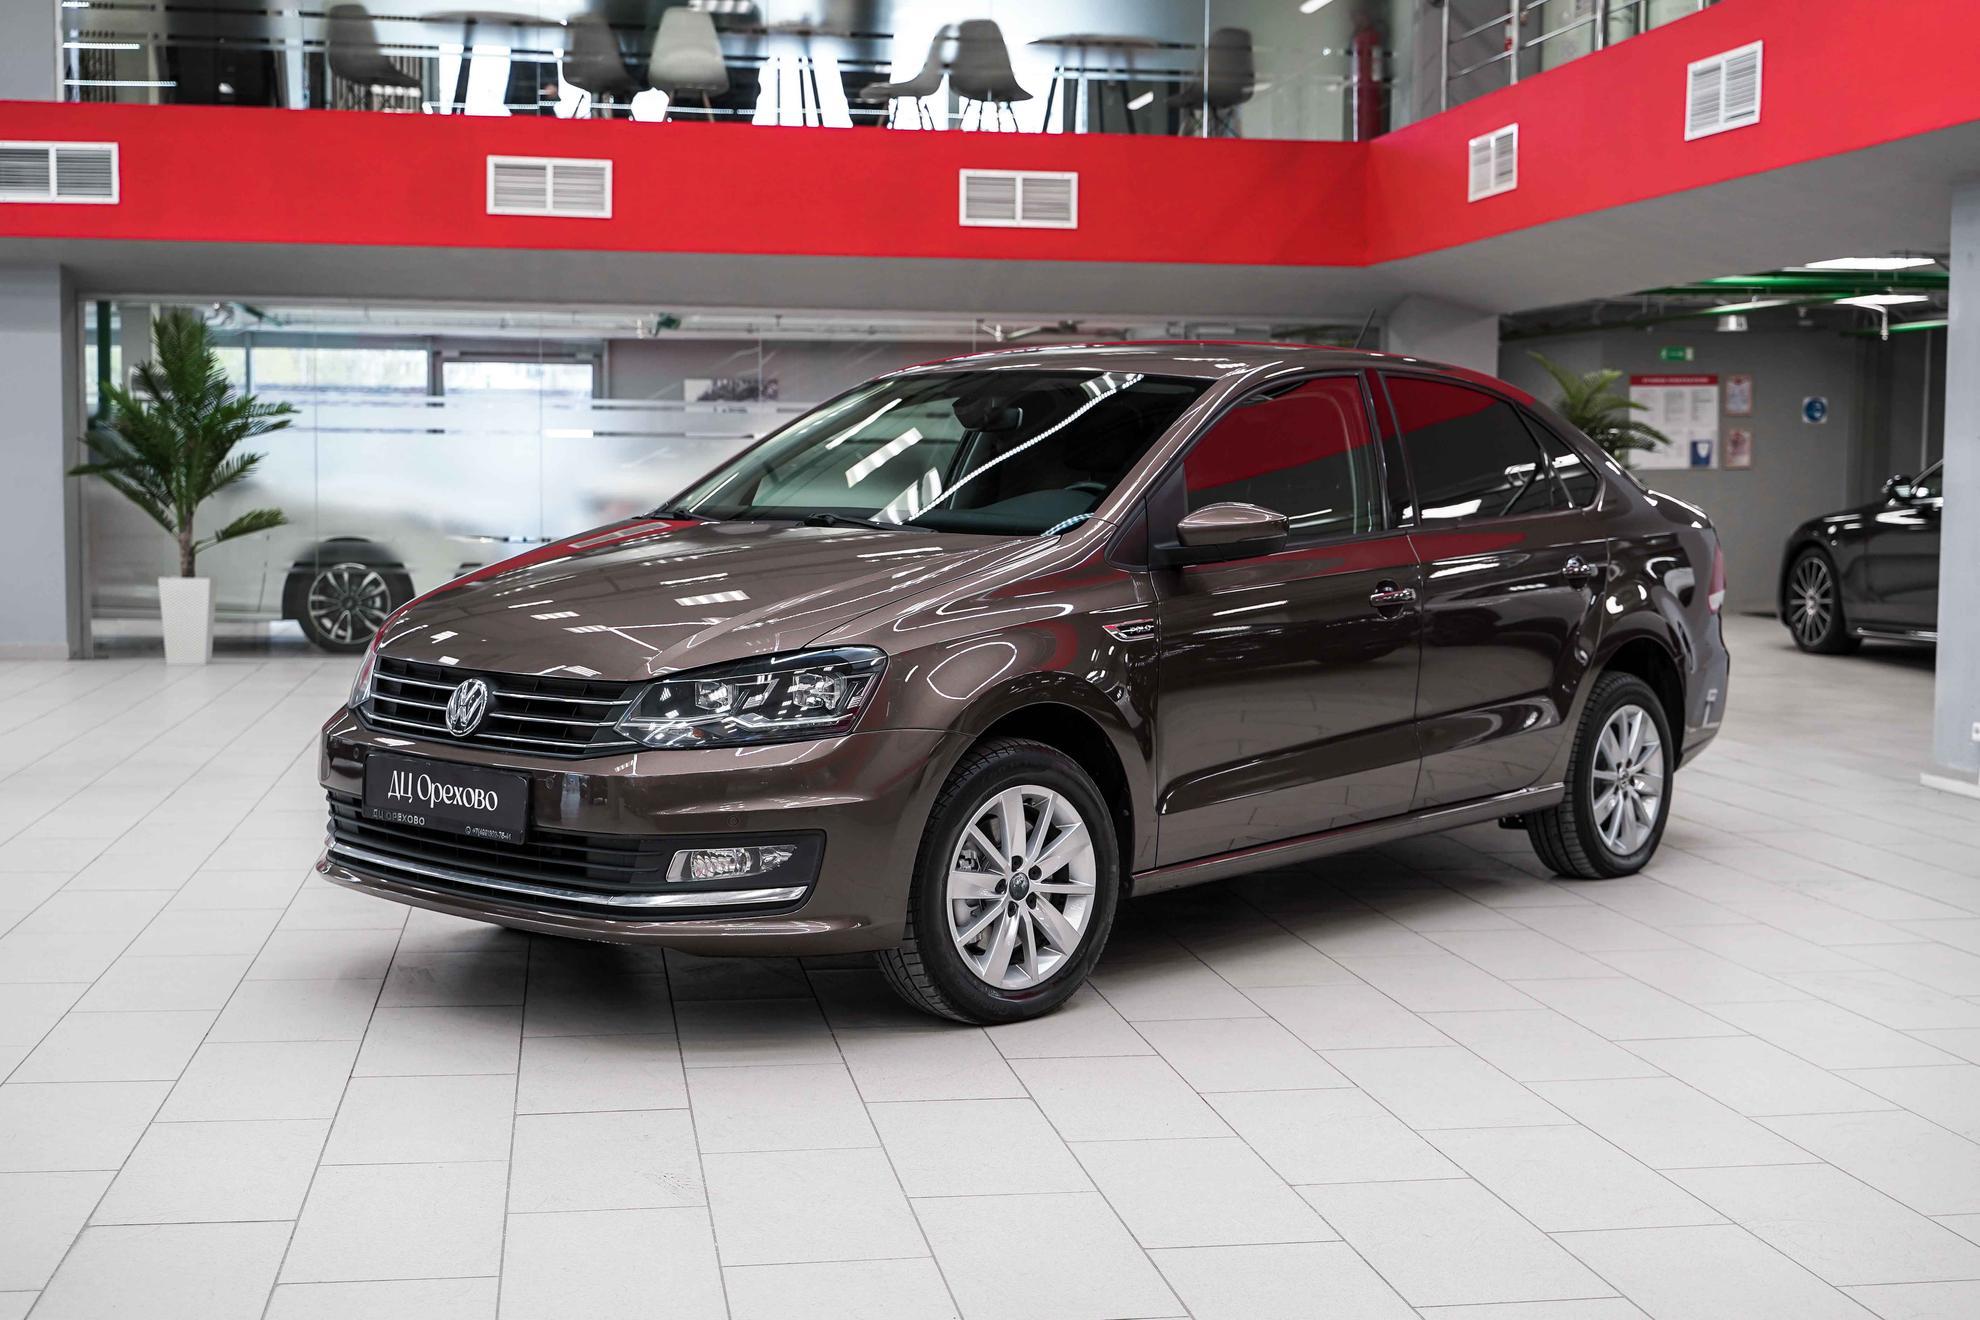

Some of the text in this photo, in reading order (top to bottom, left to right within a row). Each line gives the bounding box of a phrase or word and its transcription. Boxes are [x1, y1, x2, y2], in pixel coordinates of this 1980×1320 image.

[387, 770, 498, 811] ДЦ Орехово
[386, 812, 425, 826] ОРЕХОВО
